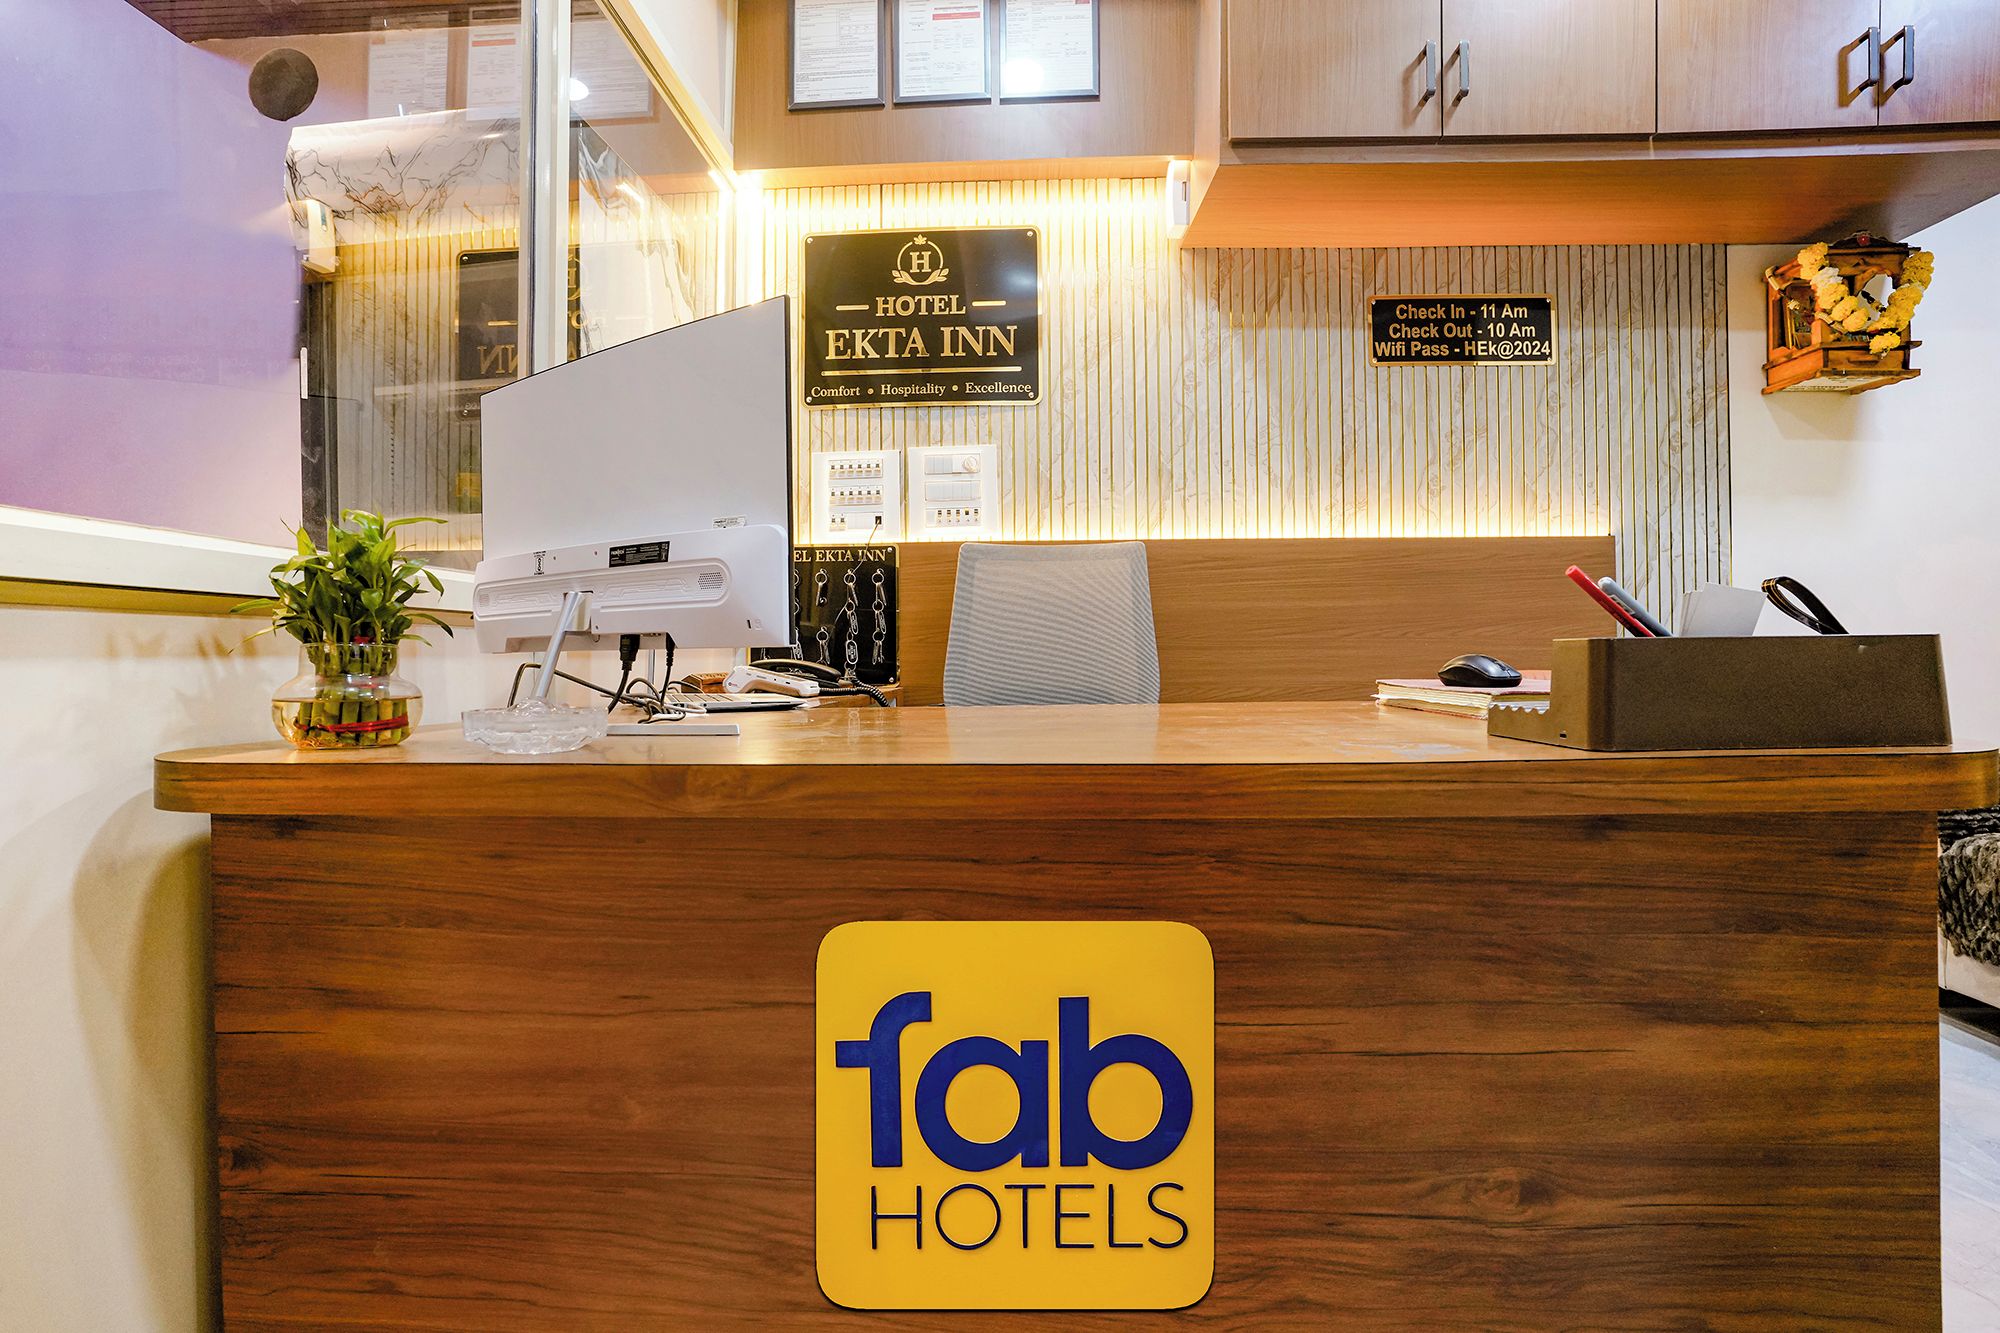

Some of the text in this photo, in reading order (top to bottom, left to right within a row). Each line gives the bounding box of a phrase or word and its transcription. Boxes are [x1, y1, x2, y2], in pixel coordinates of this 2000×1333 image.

[910, 251, 931, 273] H
[875, 294, 966, 317] HOTEL
[1396, 304, 1446, 320] Check
[1451, 304, 1465, 319] In
[1480, 304, 1496, 319] 11
[1501, 304, 1528, 319] Am
[1388, 323, 1439, 339] Check
[1443, 323, 1473, 339] Out
[1487, 323, 1505, 338] 10
[1509, 323, 1536, 338] Am
[825, 325, 1018, 360] EKTA INN
[1374, 341, 1405, 357] Wifi
[1410, 341, 1449, 357] Pass
[1464, 340, 1551, 360] HEk@2024
[811, 382, 1032, 398] Comfort Hospitality Excellence
[815, 549, 854, 562] EKTA
[857, 549, 886, 562] INN
[835, 991, 1194, 1172] fab
[871, 1181, 1189, 1251] HOTELS
